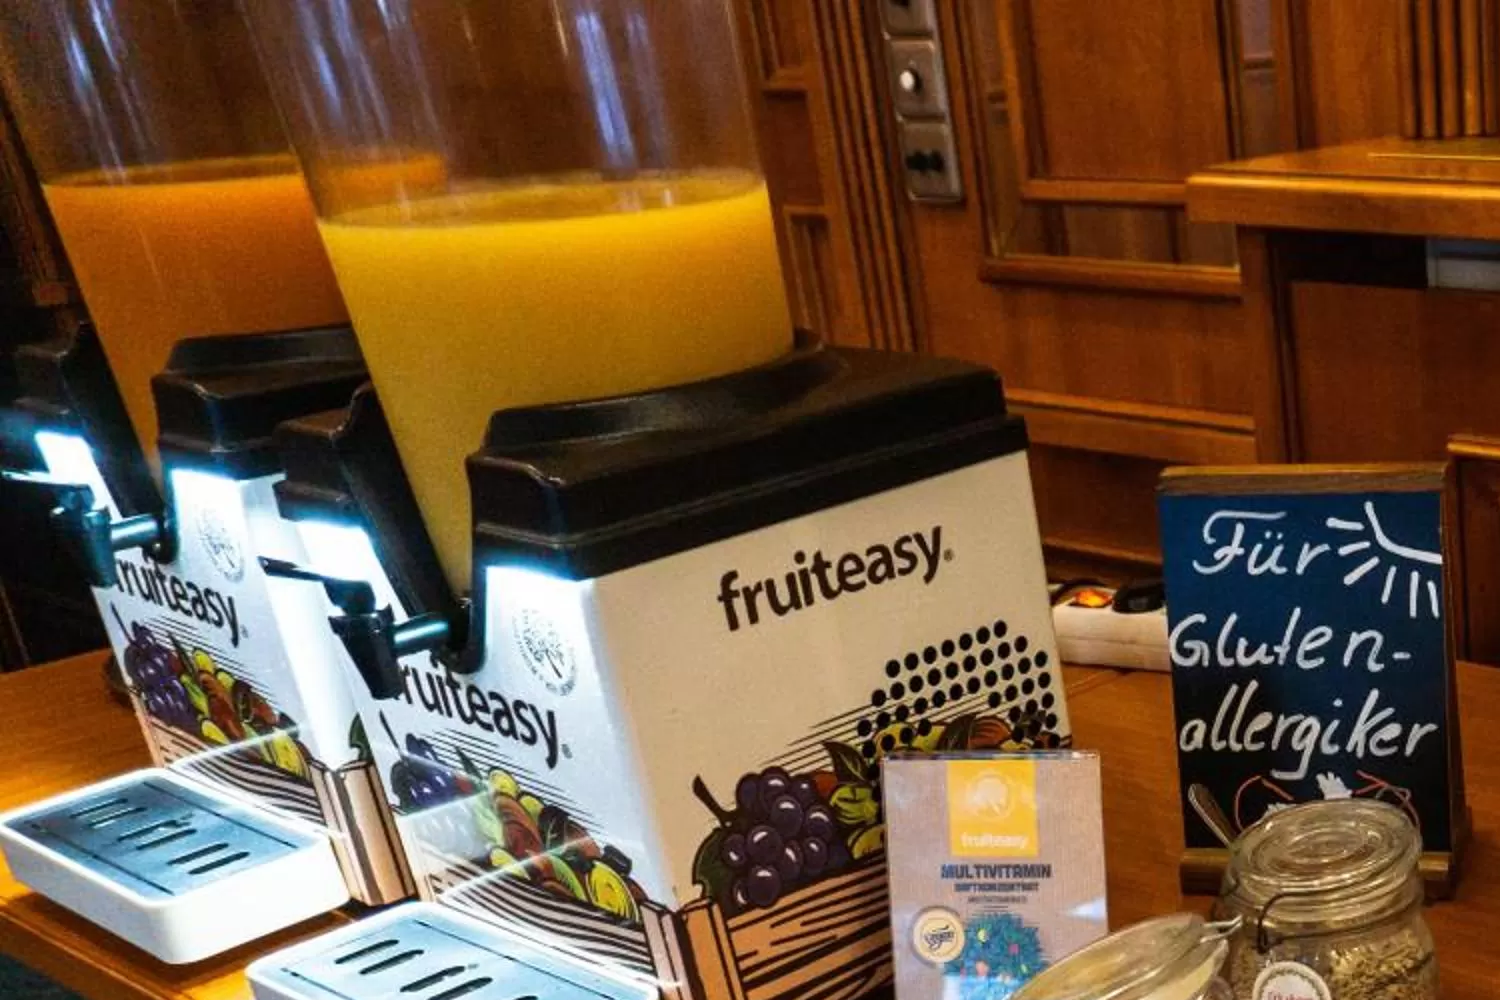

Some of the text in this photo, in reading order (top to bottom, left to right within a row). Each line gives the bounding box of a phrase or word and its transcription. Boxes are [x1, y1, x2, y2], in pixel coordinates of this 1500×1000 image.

[717, 525, 942, 632] fruiteasy
[1192, 509, 1332, 575] Für
[1169, 607, 1411, 672] Gluten-
[400, 656, 558, 769] ruiteasy
[1179, 680, 1438, 780] allergiker
[941, 863, 1052, 879] MULTIVITAMIN
